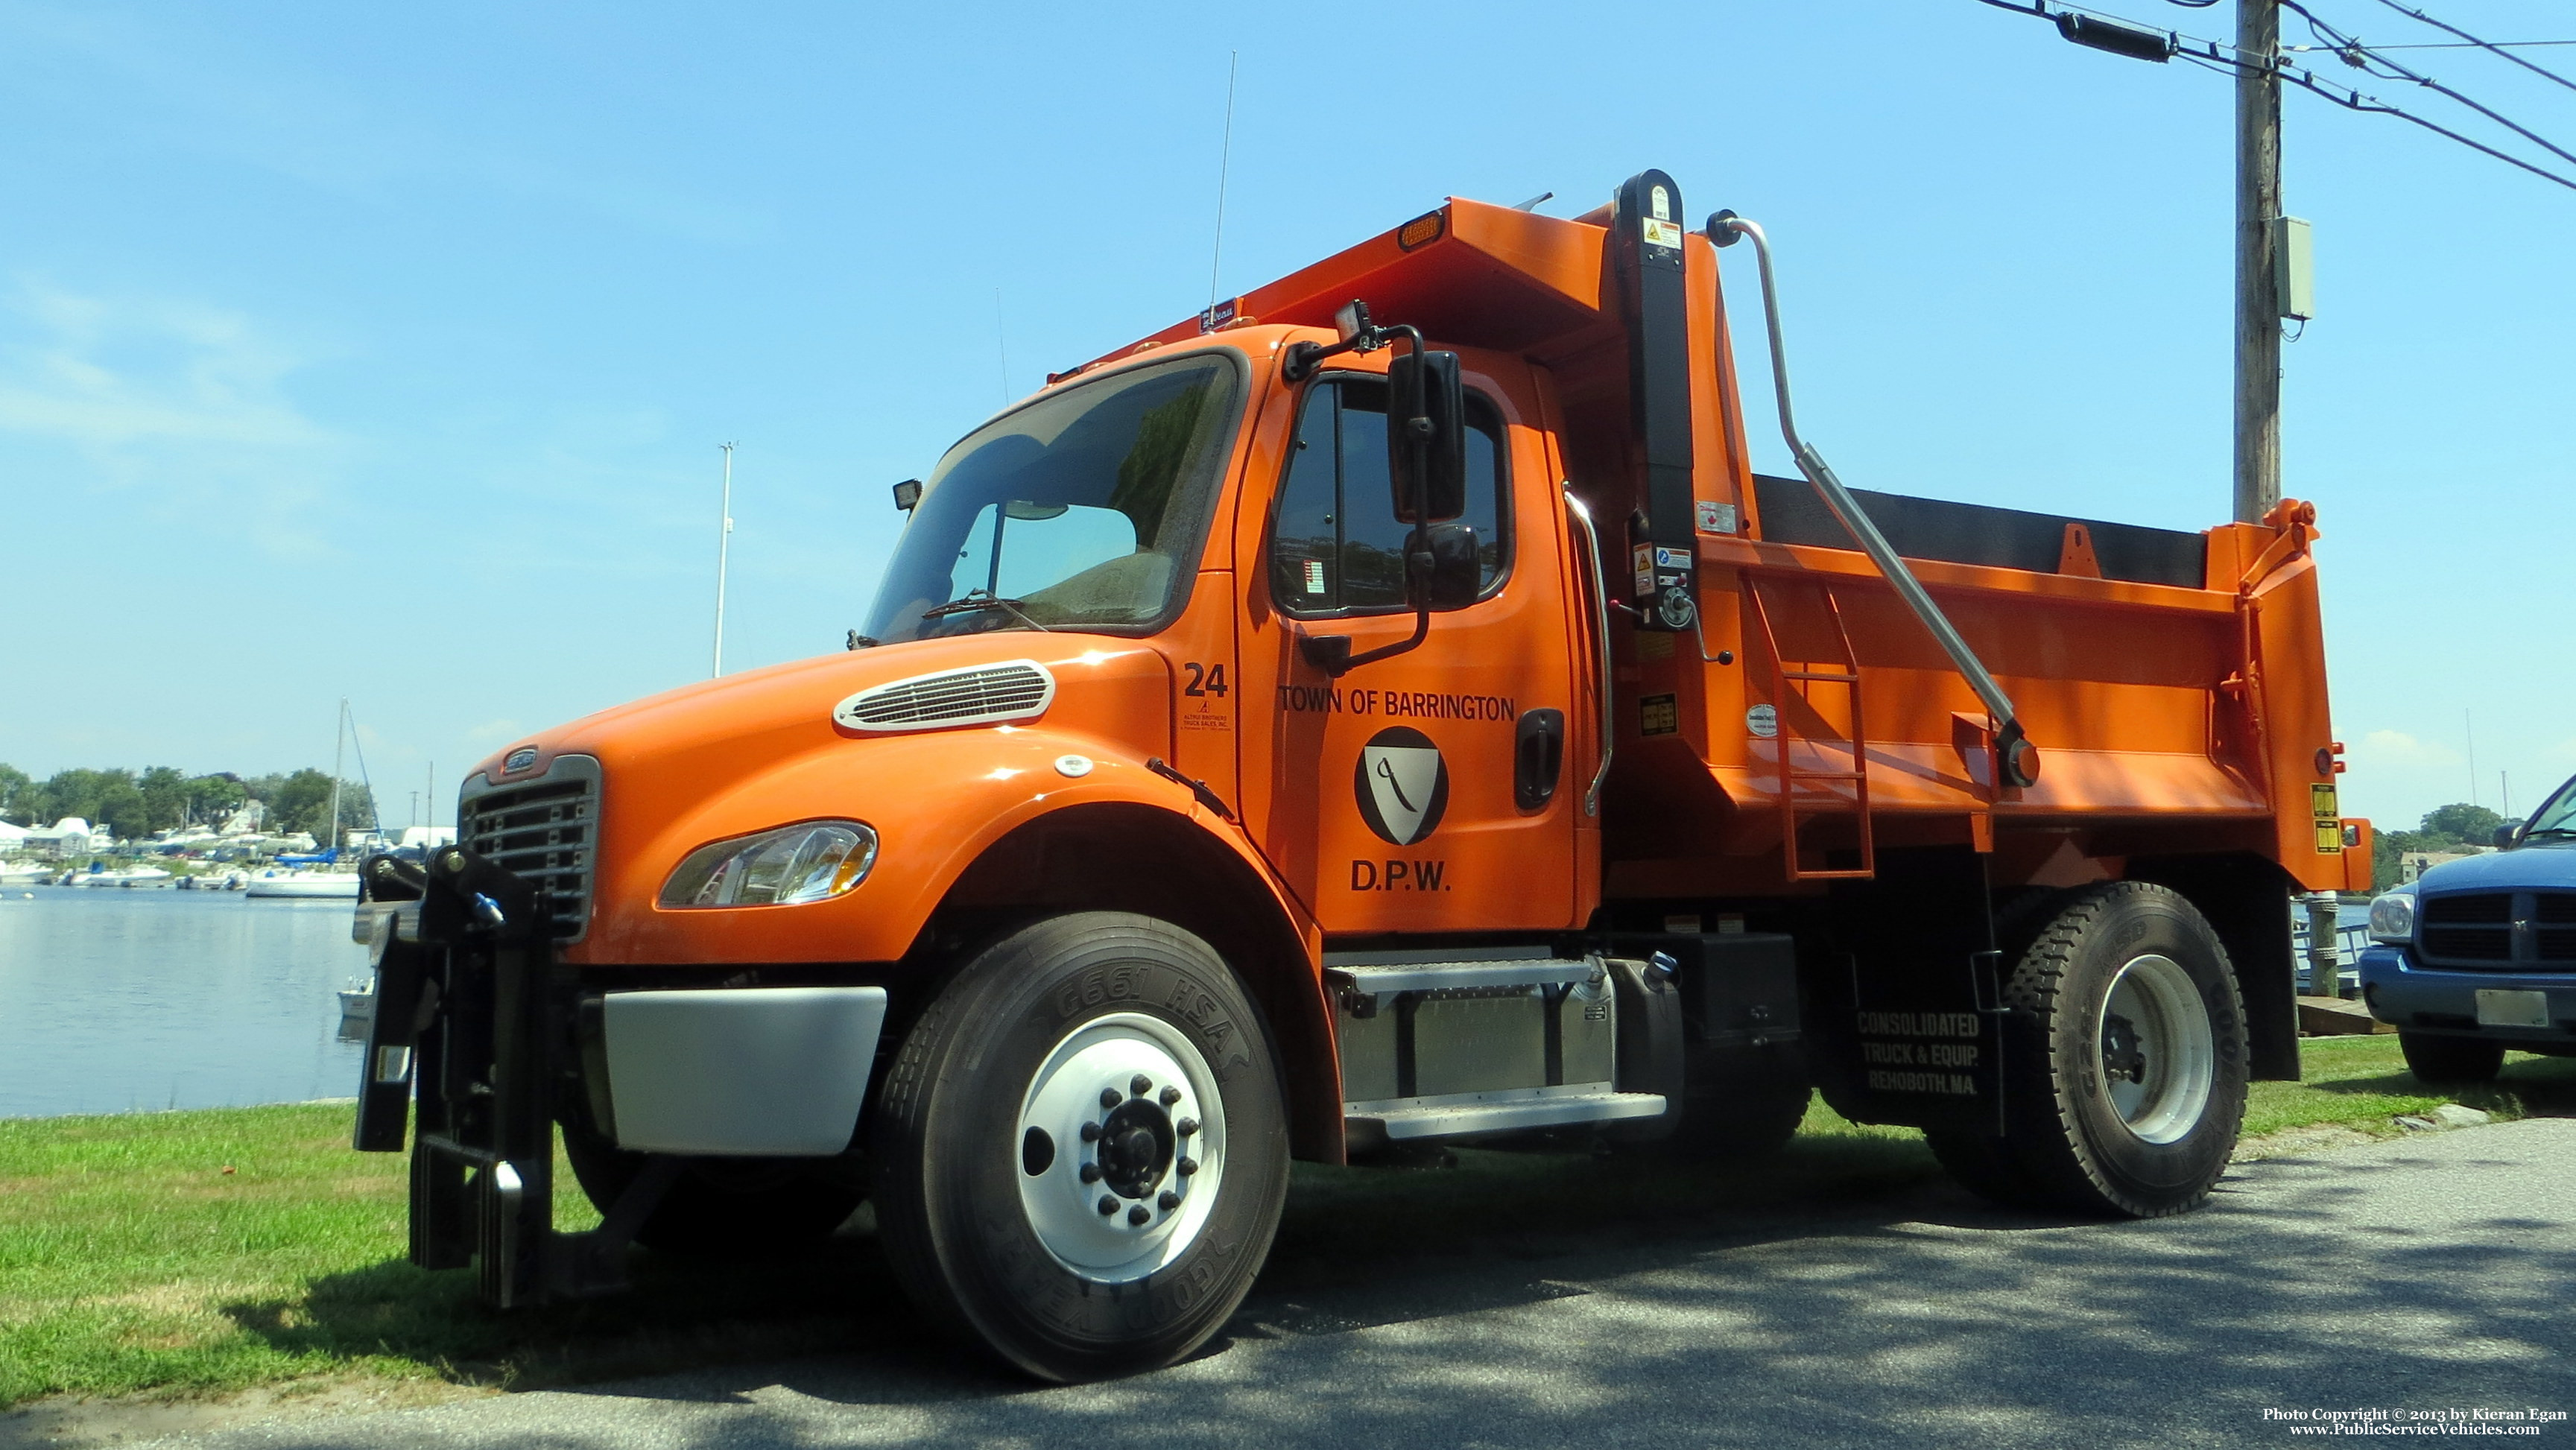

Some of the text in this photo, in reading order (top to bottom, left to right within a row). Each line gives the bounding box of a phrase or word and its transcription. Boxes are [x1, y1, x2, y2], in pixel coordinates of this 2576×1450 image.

[1184, 662, 1228, 697] 24
[1278, 685, 1515, 722] TOWN OF BARRINGTON
[1351, 859, 1452, 891] D.P.W.
[1056, 966, 1235, 1054] G661 HSA
[1856, 1011, 1980, 1037] CONSOLIDATED
[1861, 1042, 1979, 1068] TRUCK & EQUIP.
